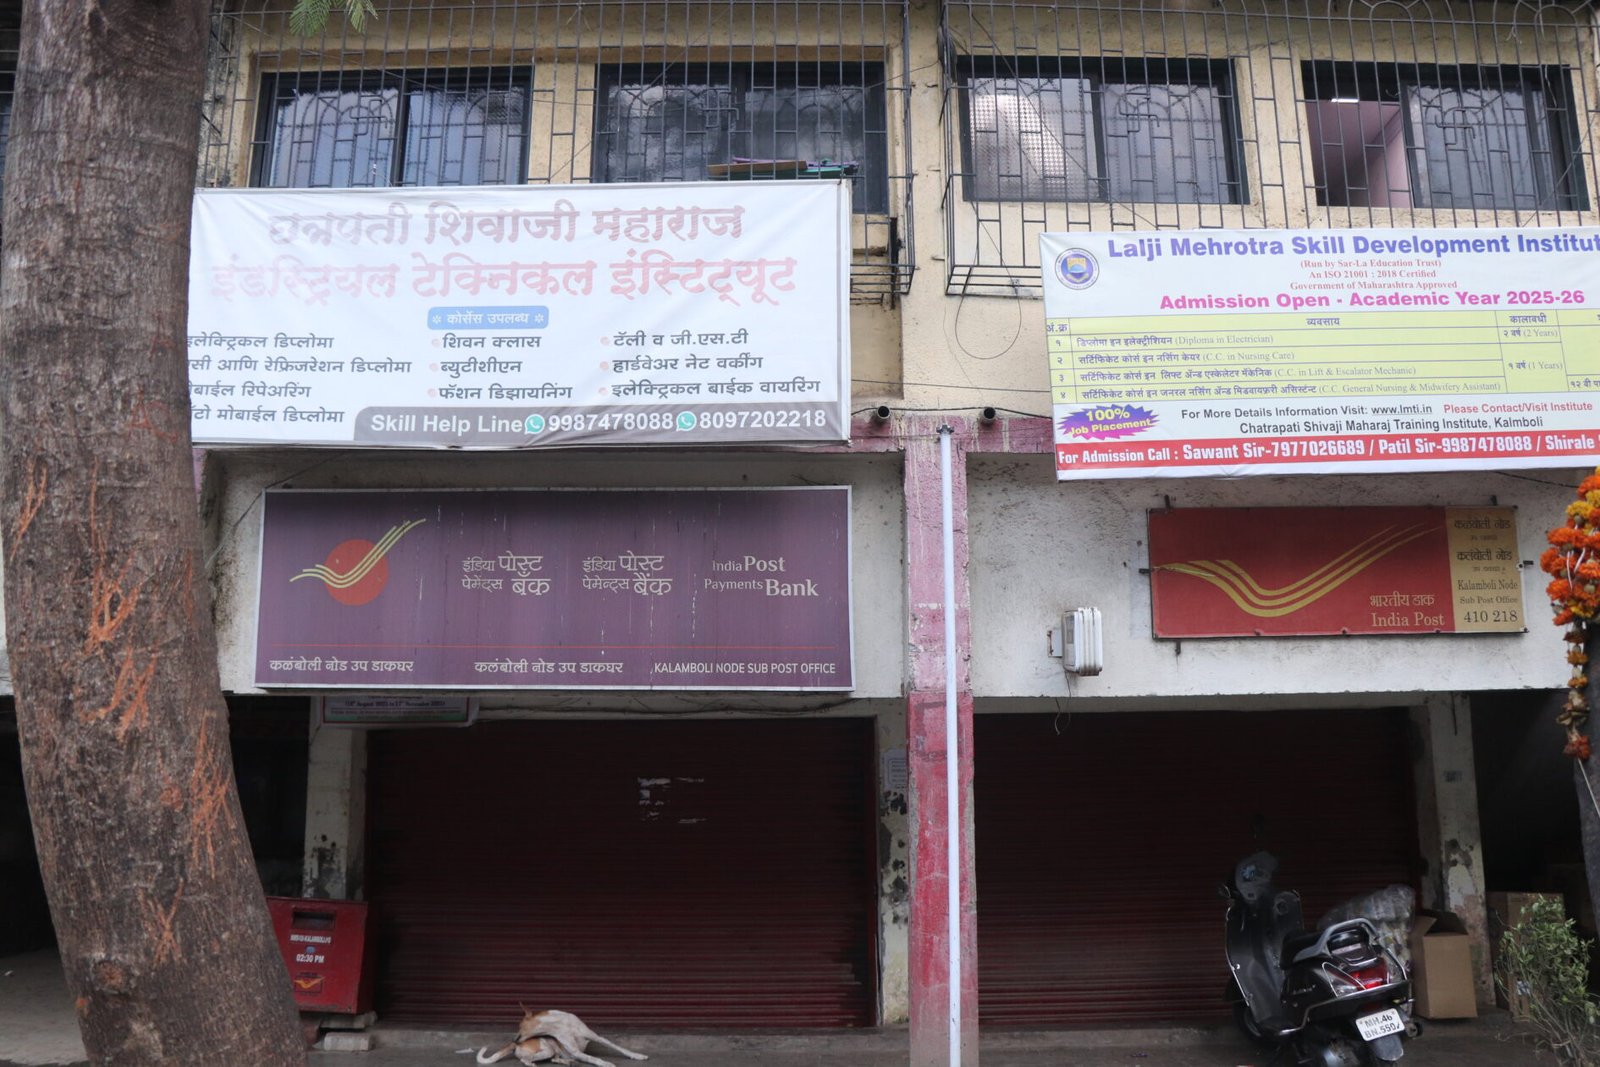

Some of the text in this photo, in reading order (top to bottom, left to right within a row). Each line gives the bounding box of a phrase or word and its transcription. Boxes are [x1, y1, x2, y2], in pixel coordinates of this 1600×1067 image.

[425, 199, 580, 247] शिवाजी
[592, 205, 745, 243] महाराज
[1108, 238, 1162, 261] Lalji
[1170, 237, 1284, 257] Mehrotra
[1292, 235, 1345, 255] Skill
[1353, 234, 1510, 258] Development
[1300, 258, 1442, 269] (Run by Sar-La Education Trust)
[1309, 269, 1437, 279] An ISO 21001 2018 Certified
[1290, 280, 1458, 291] Government of Maharashtra Approved
[1160, 290, 1586, 310] Admission Open Academic Year 2025-26
[274, 332, 334, 349] डिप्लोमा
[442, 333, 541, 349] शिवन क्लास
[652, 335, 663, 347] व
[1175, 335, 1214, 346] (Diploma
[1226, 335, 1274, 345] Electrician)
[188, 355, 211, 371] सी
[217, 356, 259, 372] आणि
[350, 357, 413, 375] डिप्लोमा
[684, 353, 710, 371] नेट
[1227, 353, 1235, 361] in
[1237, 352, 1270, 362] Nursing
[1271, 351, 1295, 361] Care)
[1298, 369, 1306, 377] in
[1307, 367, 1324, 376] Lift
[1335, 367, 1371, 376] Escalator
[1373, 366, 1417, 376] Mechanic)
[439, 382, 482, 400] फॅशन
[707, 377, 753, 396] बाईक
[759, 375, 820, 394] वायरिंग
[1342, 384, 1375, 394] General
[1376, 384, 1408, 394] Nursing
[1419, 382, 1461, 393] Midwifery
[1462, 381, 1501, 392] Assistant)
[217, 405, 345, 423] मोबाईल डिप्लोमा
[1086, 408, 1131, 422] 100%
[1181, 401, 1593, 419] For More Details Information Visit: www.lmti.in Please Contact/Visit Institute
[371, 409, 826, 437] Skill Help Line 9987478088 8097202218
[1069, 418, 1151, 436] Job Placement
[1240, 415, 1543, 436] Chatrapati Shivaji Maharaj Training Institute, Kalmboli
[1058, 450, 1079, 464] For
[1082, 447, 1145, 463] Admission
[1147, 447, 1170, 461] Call
[1183, 443, 1238, 460] Sawant
[1243, 439, 1365, 458] Sir-7977026689
[1379, 438, 1411, 454] Patil
[1415, 435, 1532, 453] Sir-9987478088
[1545, 433, 1595, 450] Shirale
[462, 550, 544, 573] इंडिया पोस्ट
[582, 550, 664, 573] इंडिया पोस्ट
[712, 555, 786, 572] India Post
[632, 572, 673, 595] बैंक
[704, 578, 819, 596] Payments Bank
[1498, 580, 1518, 590] Node
[1370, 591, 1435, 607] भारतीय डाक
[1459, 596, 1518, 605] Sub Post Office
[1371, 613, 1445, 627] India Post
[1464, 610, 1518, 623] 410 218
[325, 656, 347, 671] नोड
[351, 660, 368, 672] उप
[371, 660, 414, 672] डाकघर
[474, 657, 623, 674] कलंबोली नोड उप डाकघर
[654, 662, 836, 674] KALAMBOLI NODE SUB POST OFFICE
[314, 954, 324, 963] PM
